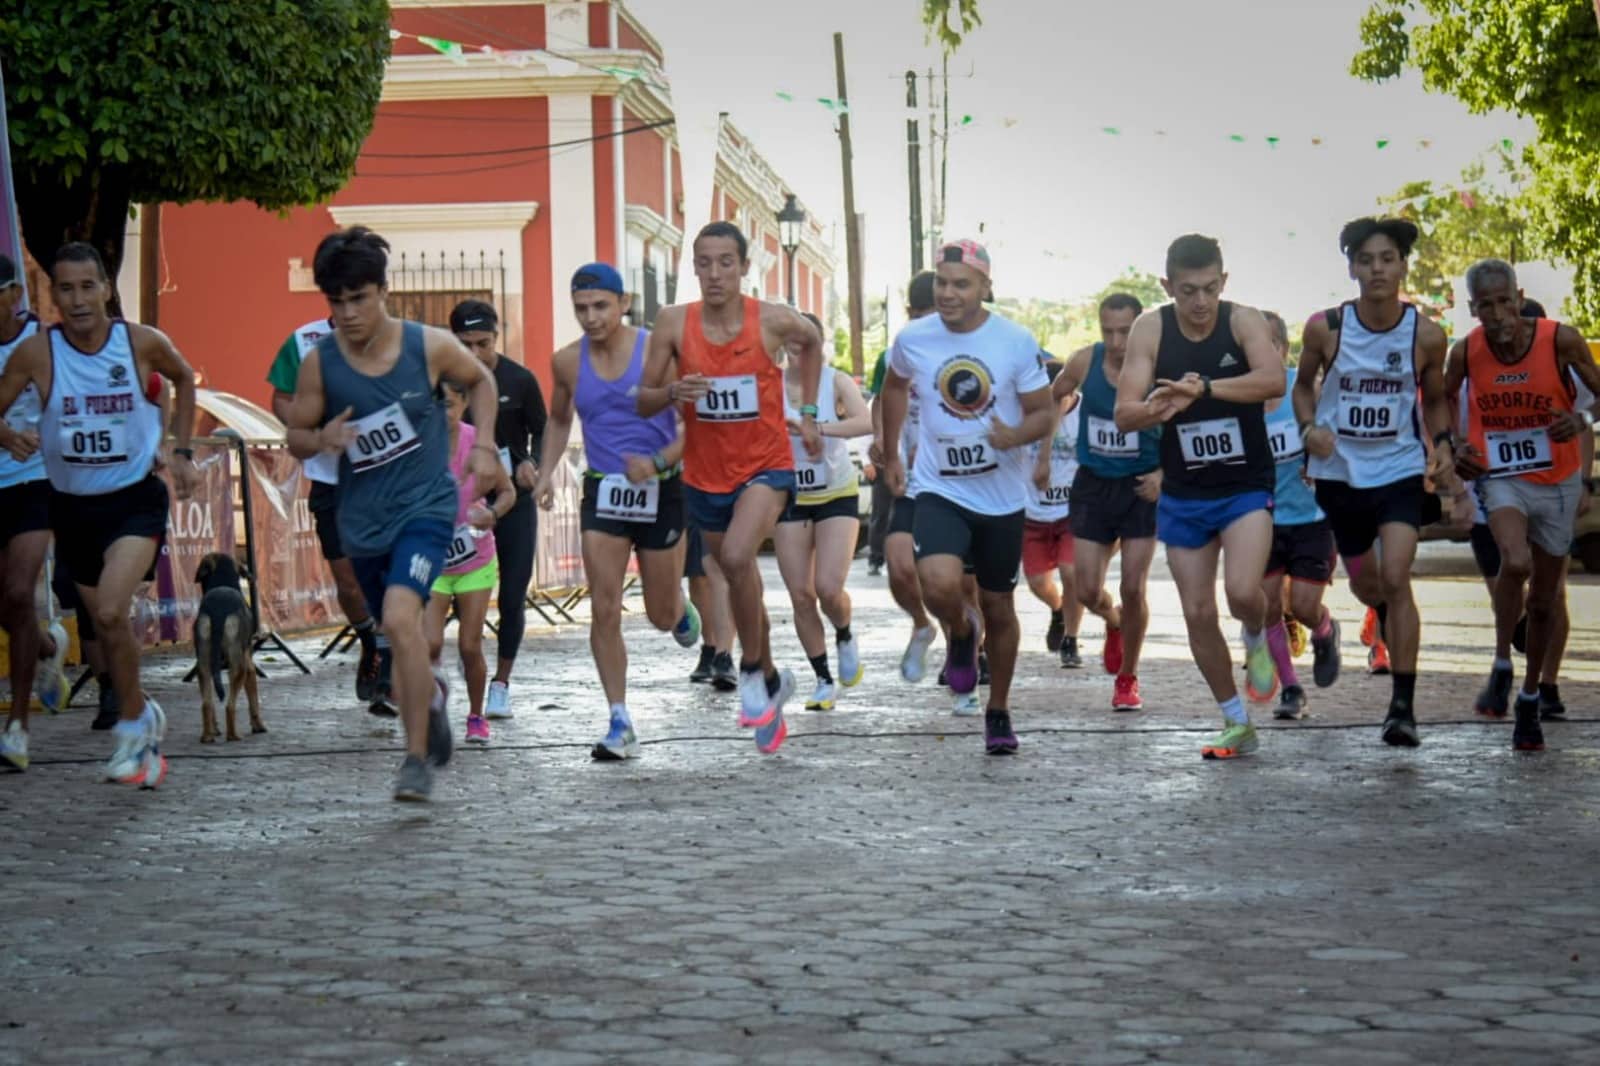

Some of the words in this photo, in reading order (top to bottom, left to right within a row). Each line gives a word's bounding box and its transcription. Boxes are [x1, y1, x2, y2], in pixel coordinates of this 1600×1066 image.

[1340, 376, 1352, 391] EL
[1359, 379, 1403, 394] FUERTE
[63, 396, 78, 415] EL
[85, 393, 133, 414] FUERTE
[706, 390, 740, 411] 011
[1477, 391, 1553, 412] DEPORTES
[1349, 406, 1390, 428] 009
[73, 430, 112, 453] 015
[357, 421, 402, 455] 006
[1097, 430, 1126, 446] 018
[1192, 433, 1232, 457] 008
[947, 444, 986, 467] 002
[1498, 439, 1536, 463] 016
[610, 487, 647, 509] 004
